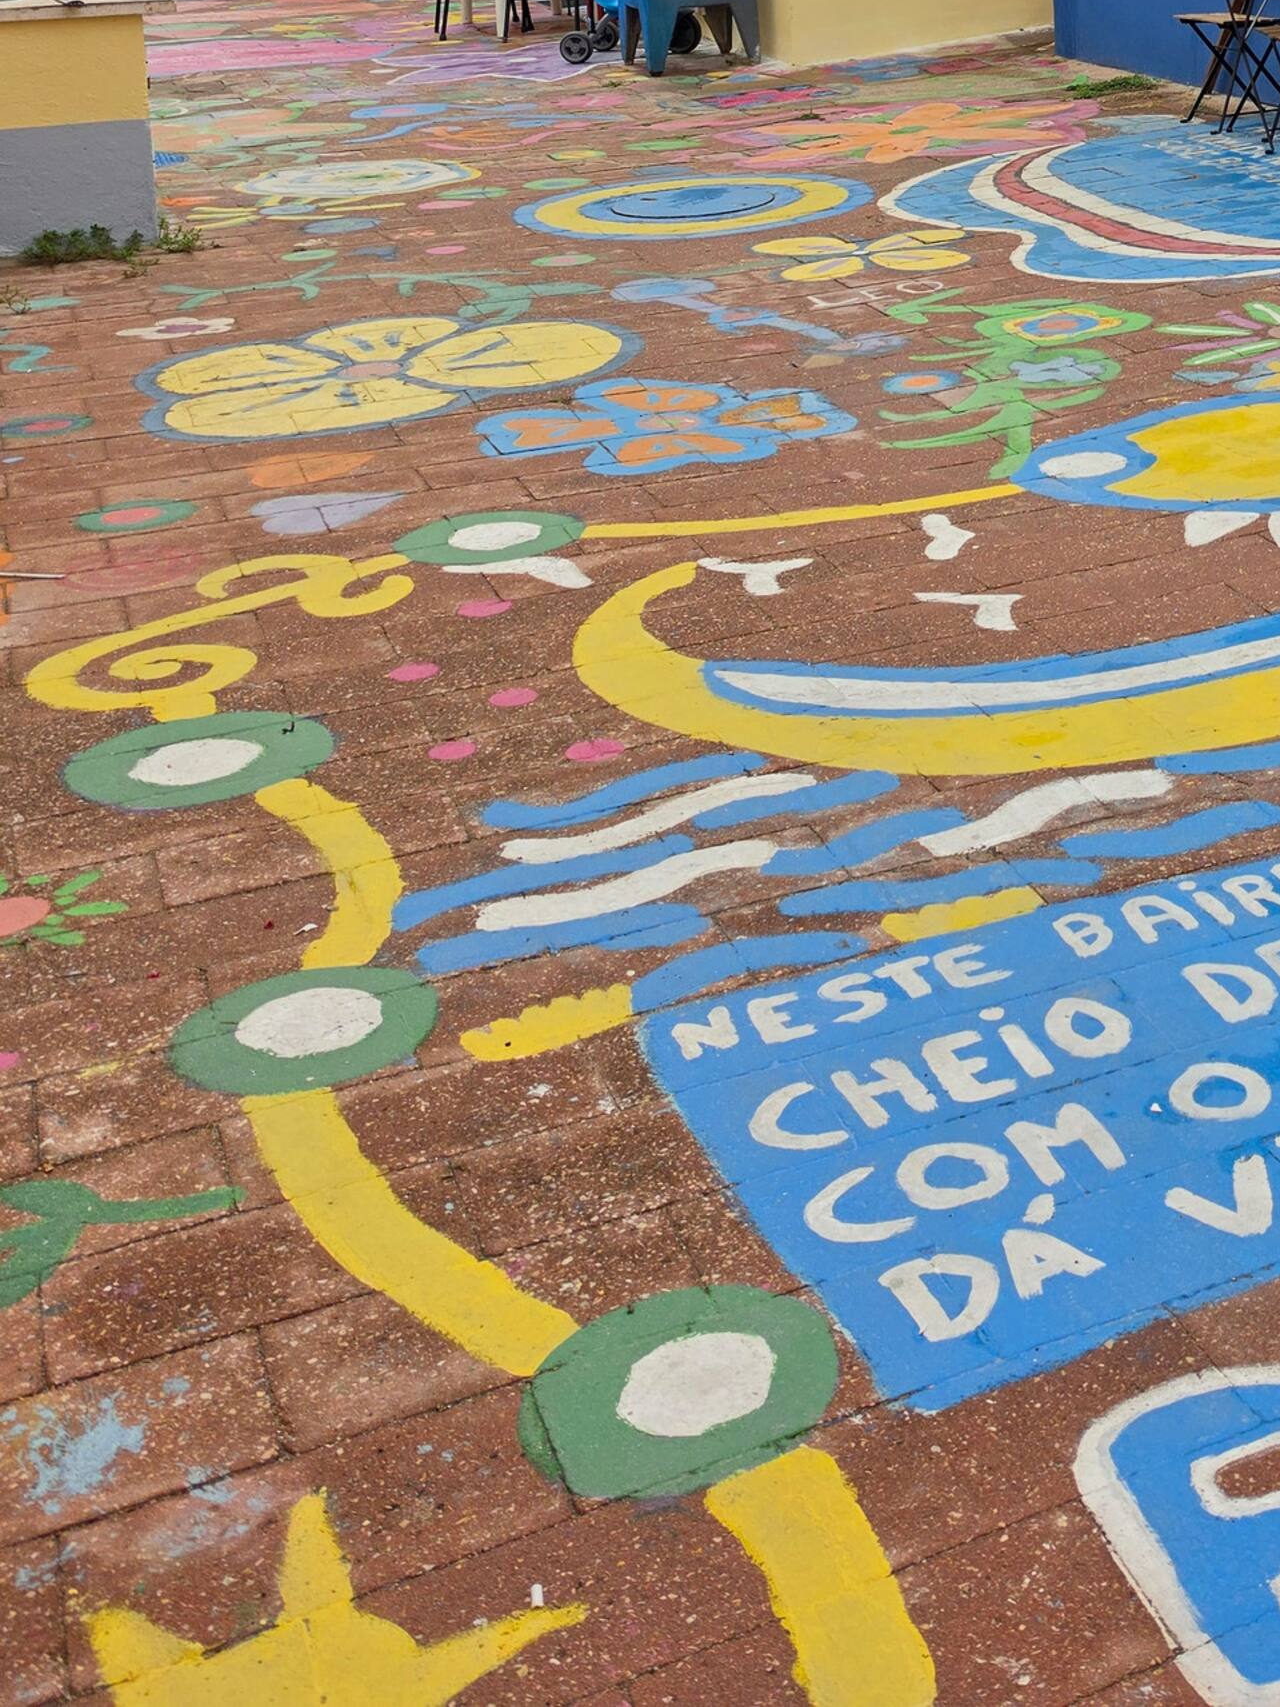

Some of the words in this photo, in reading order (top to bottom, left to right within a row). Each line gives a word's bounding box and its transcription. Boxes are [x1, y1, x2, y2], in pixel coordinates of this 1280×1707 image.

[807, 280, 944, 311] LEO
[671, 944, 1010, 1061] NESTE
[803, 1102, 1126, 1244] COM
[1168, 1061, 1272, 1121] O
[878, 1193, 1105, 1342] DÁ
